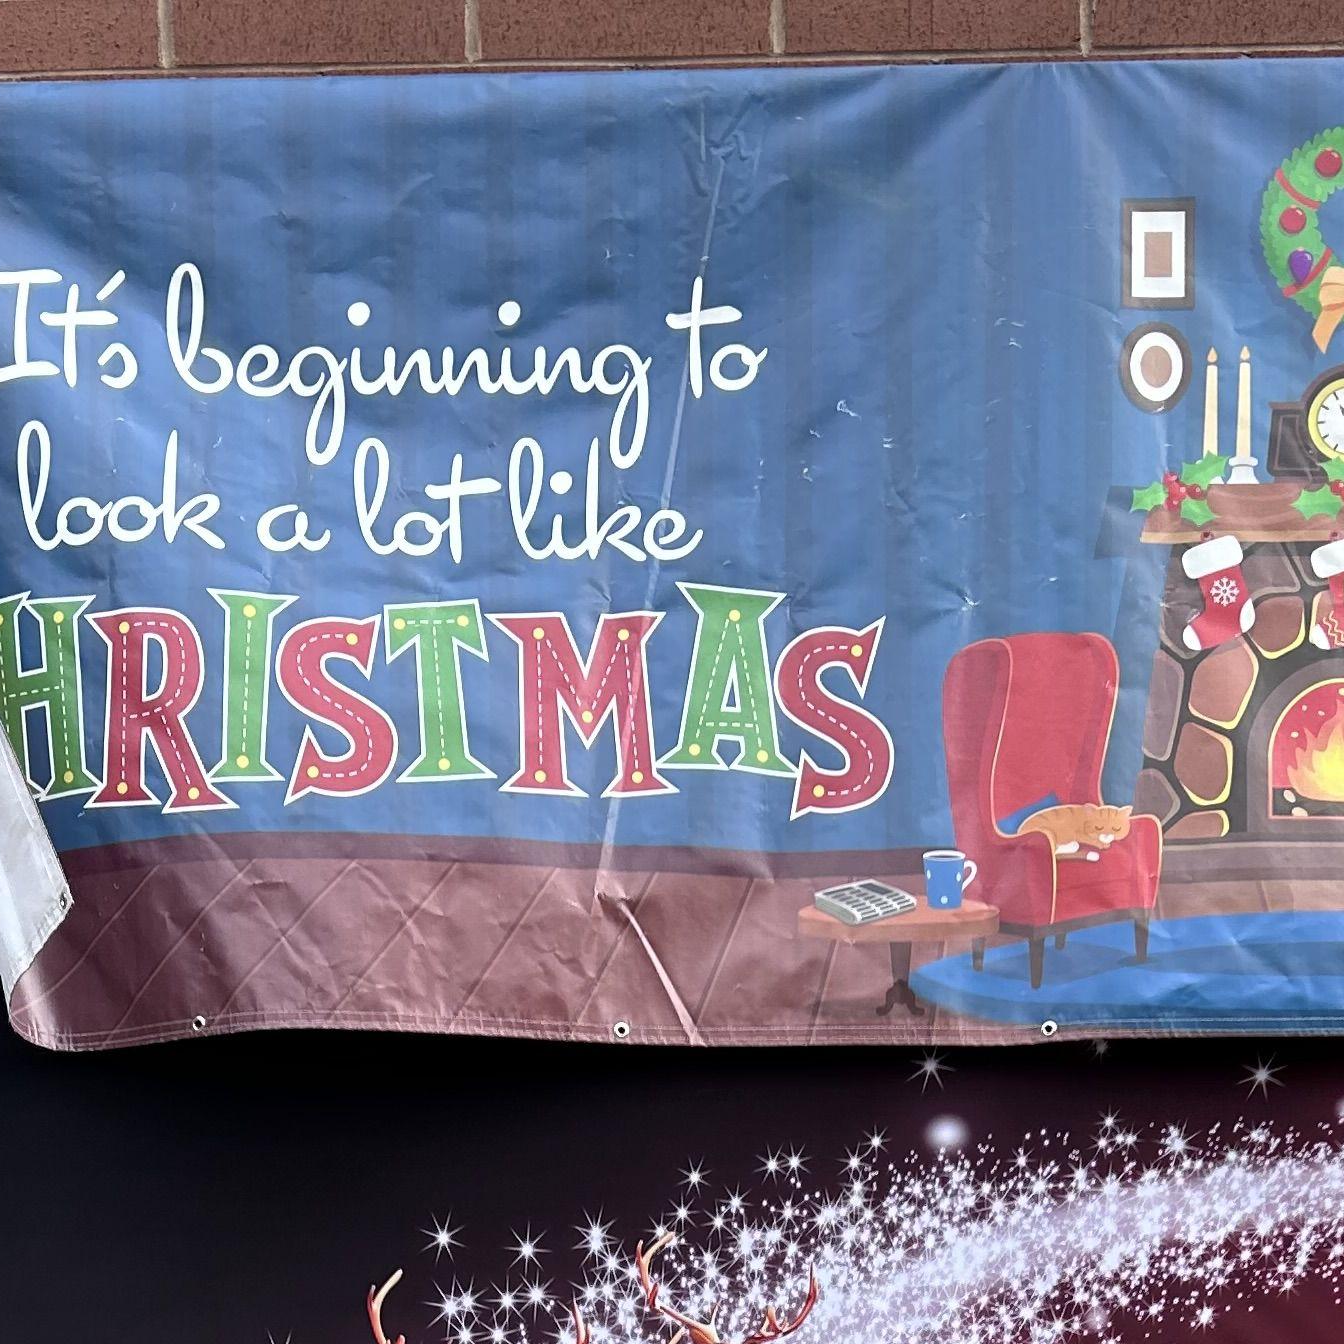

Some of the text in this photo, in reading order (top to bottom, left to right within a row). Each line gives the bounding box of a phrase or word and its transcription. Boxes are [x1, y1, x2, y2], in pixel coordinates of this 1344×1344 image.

[165, 262, 652, 469] beginning
[665, 276, 768, 398] to
[16, 420, 704, 564] look a lot like
